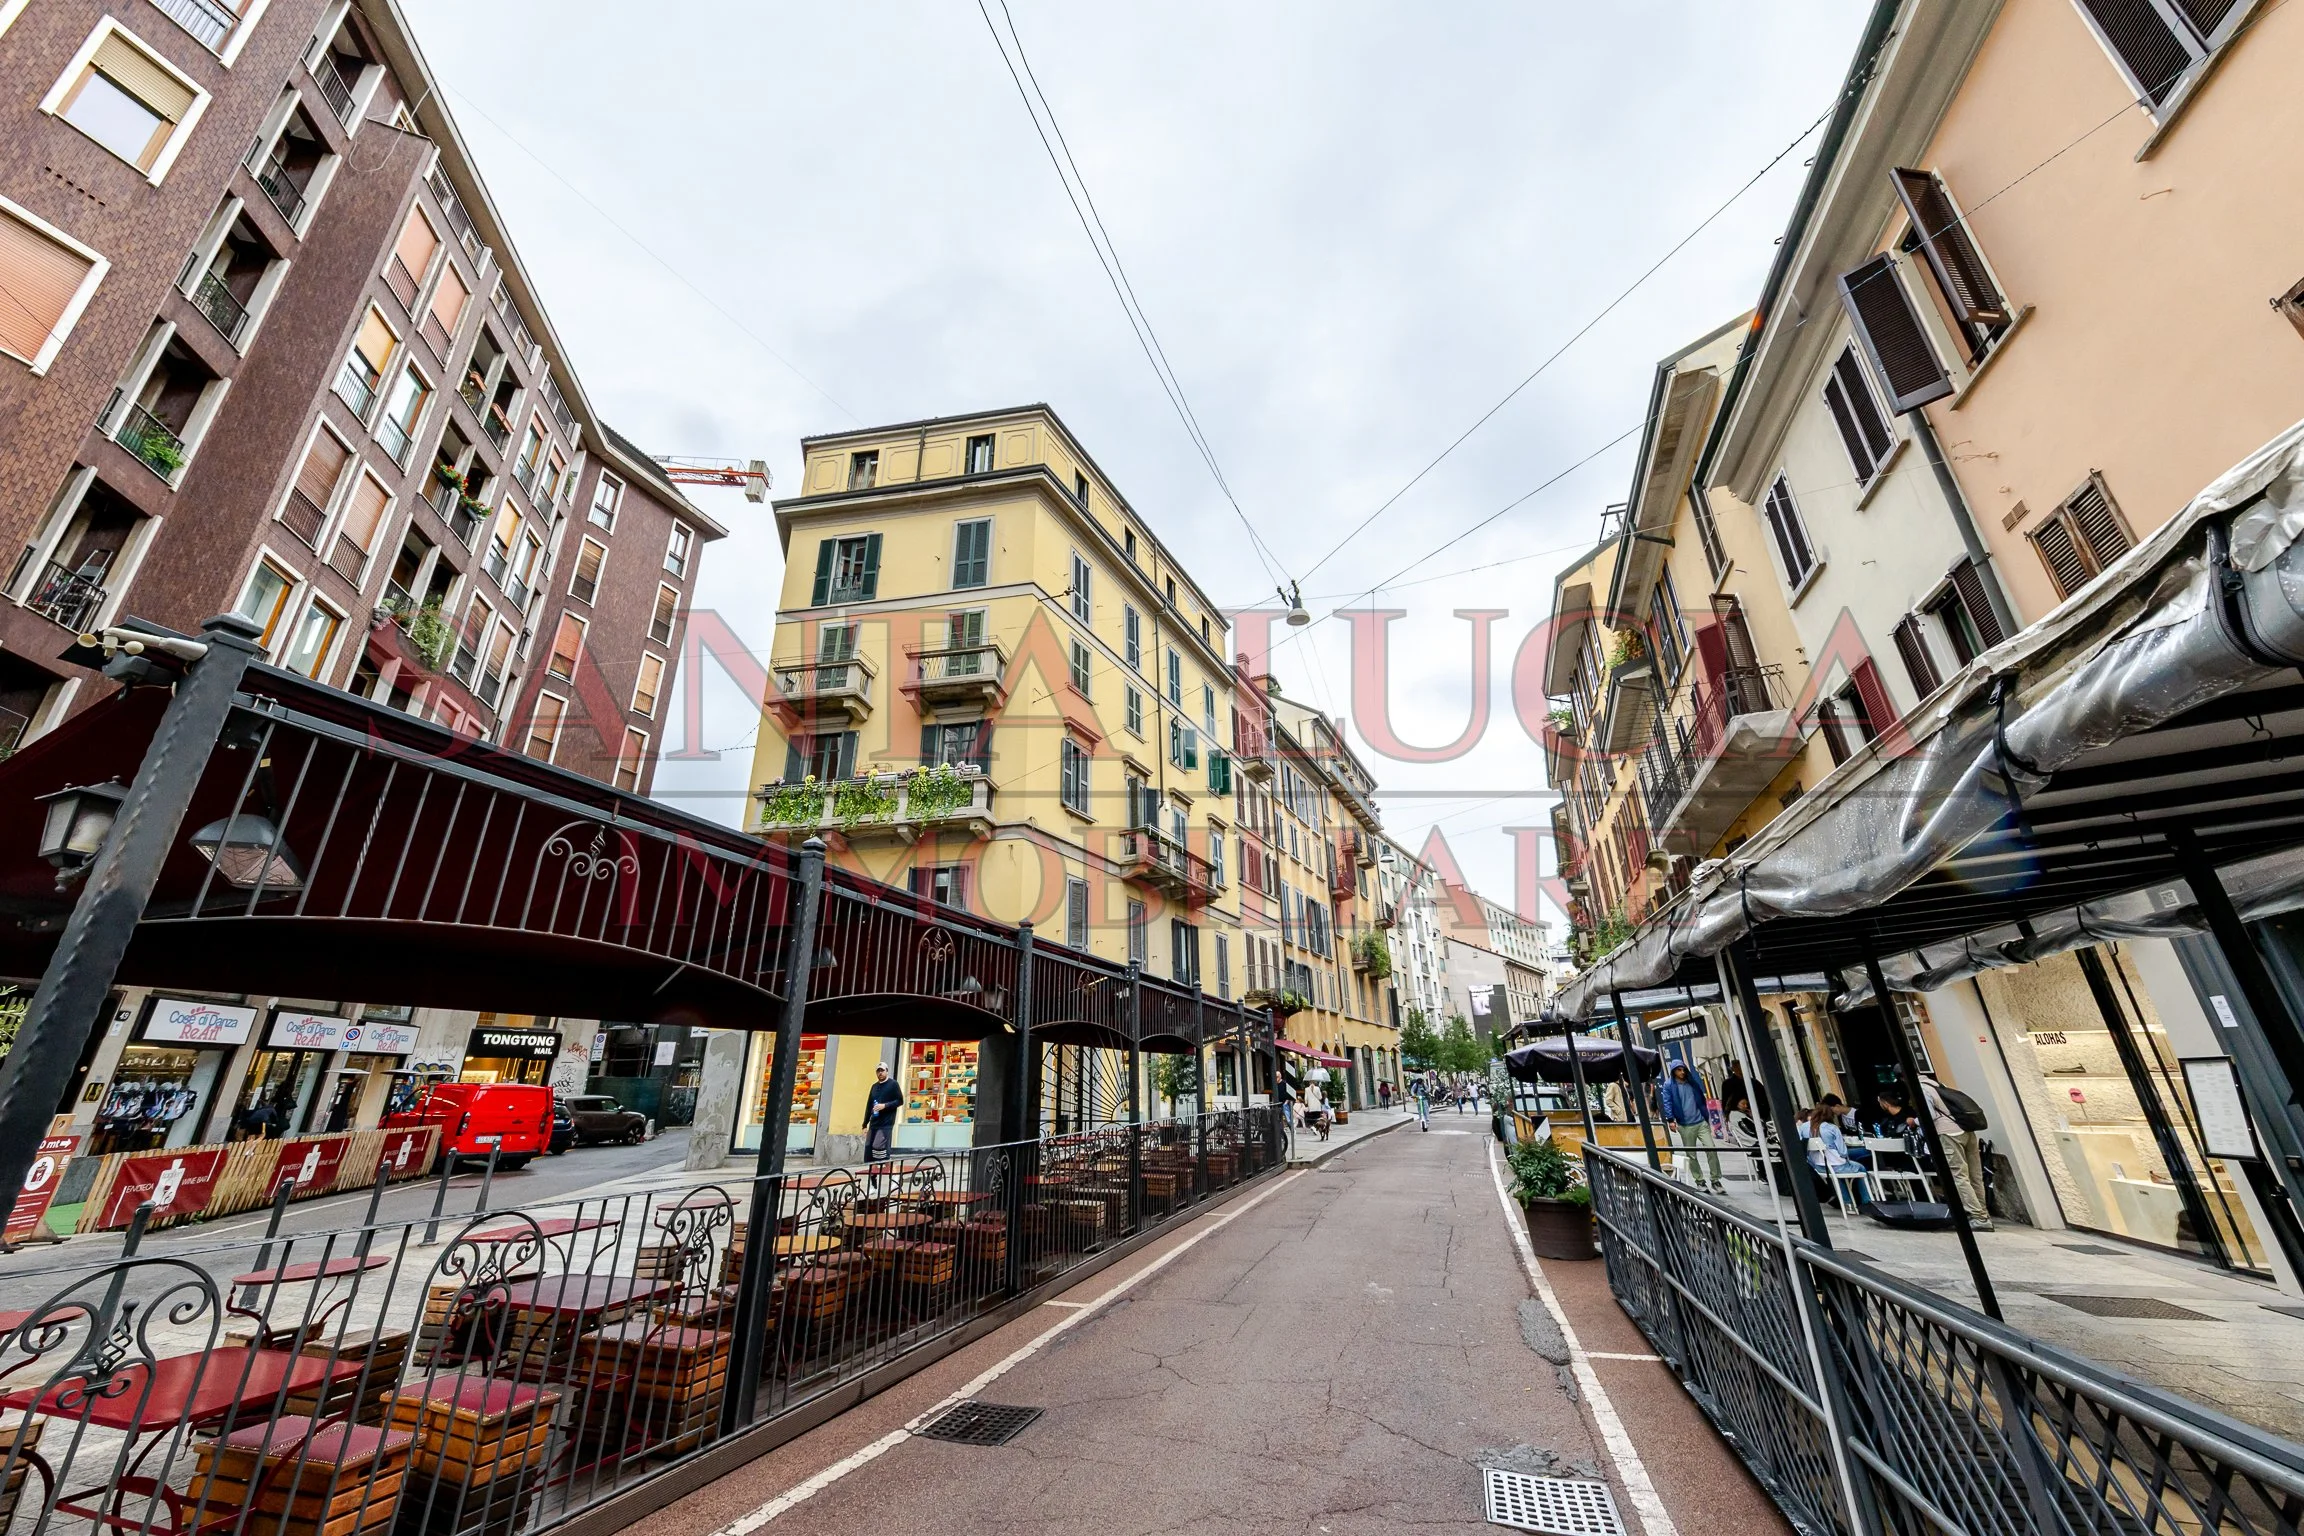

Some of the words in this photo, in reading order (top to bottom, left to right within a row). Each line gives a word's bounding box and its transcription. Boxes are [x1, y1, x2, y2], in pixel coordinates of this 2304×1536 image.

[119, 1011, 130, 1020] 49
[169, 1010, 196, 1024] Cose
[199, 1013, 209, 1026] di
[208, 1014, 239, 1028] Danza
[286, 1021, 306, 1034] Cose
[307, 1022, 315, 1034] di
[315, 1022, 337, 1036] Danza
[482, 1033, 556, 1047] TONGTONG
[2034, 1030, 2067, 1045] ALOHAS
[533, 1047, 553, 1055] NAIL
